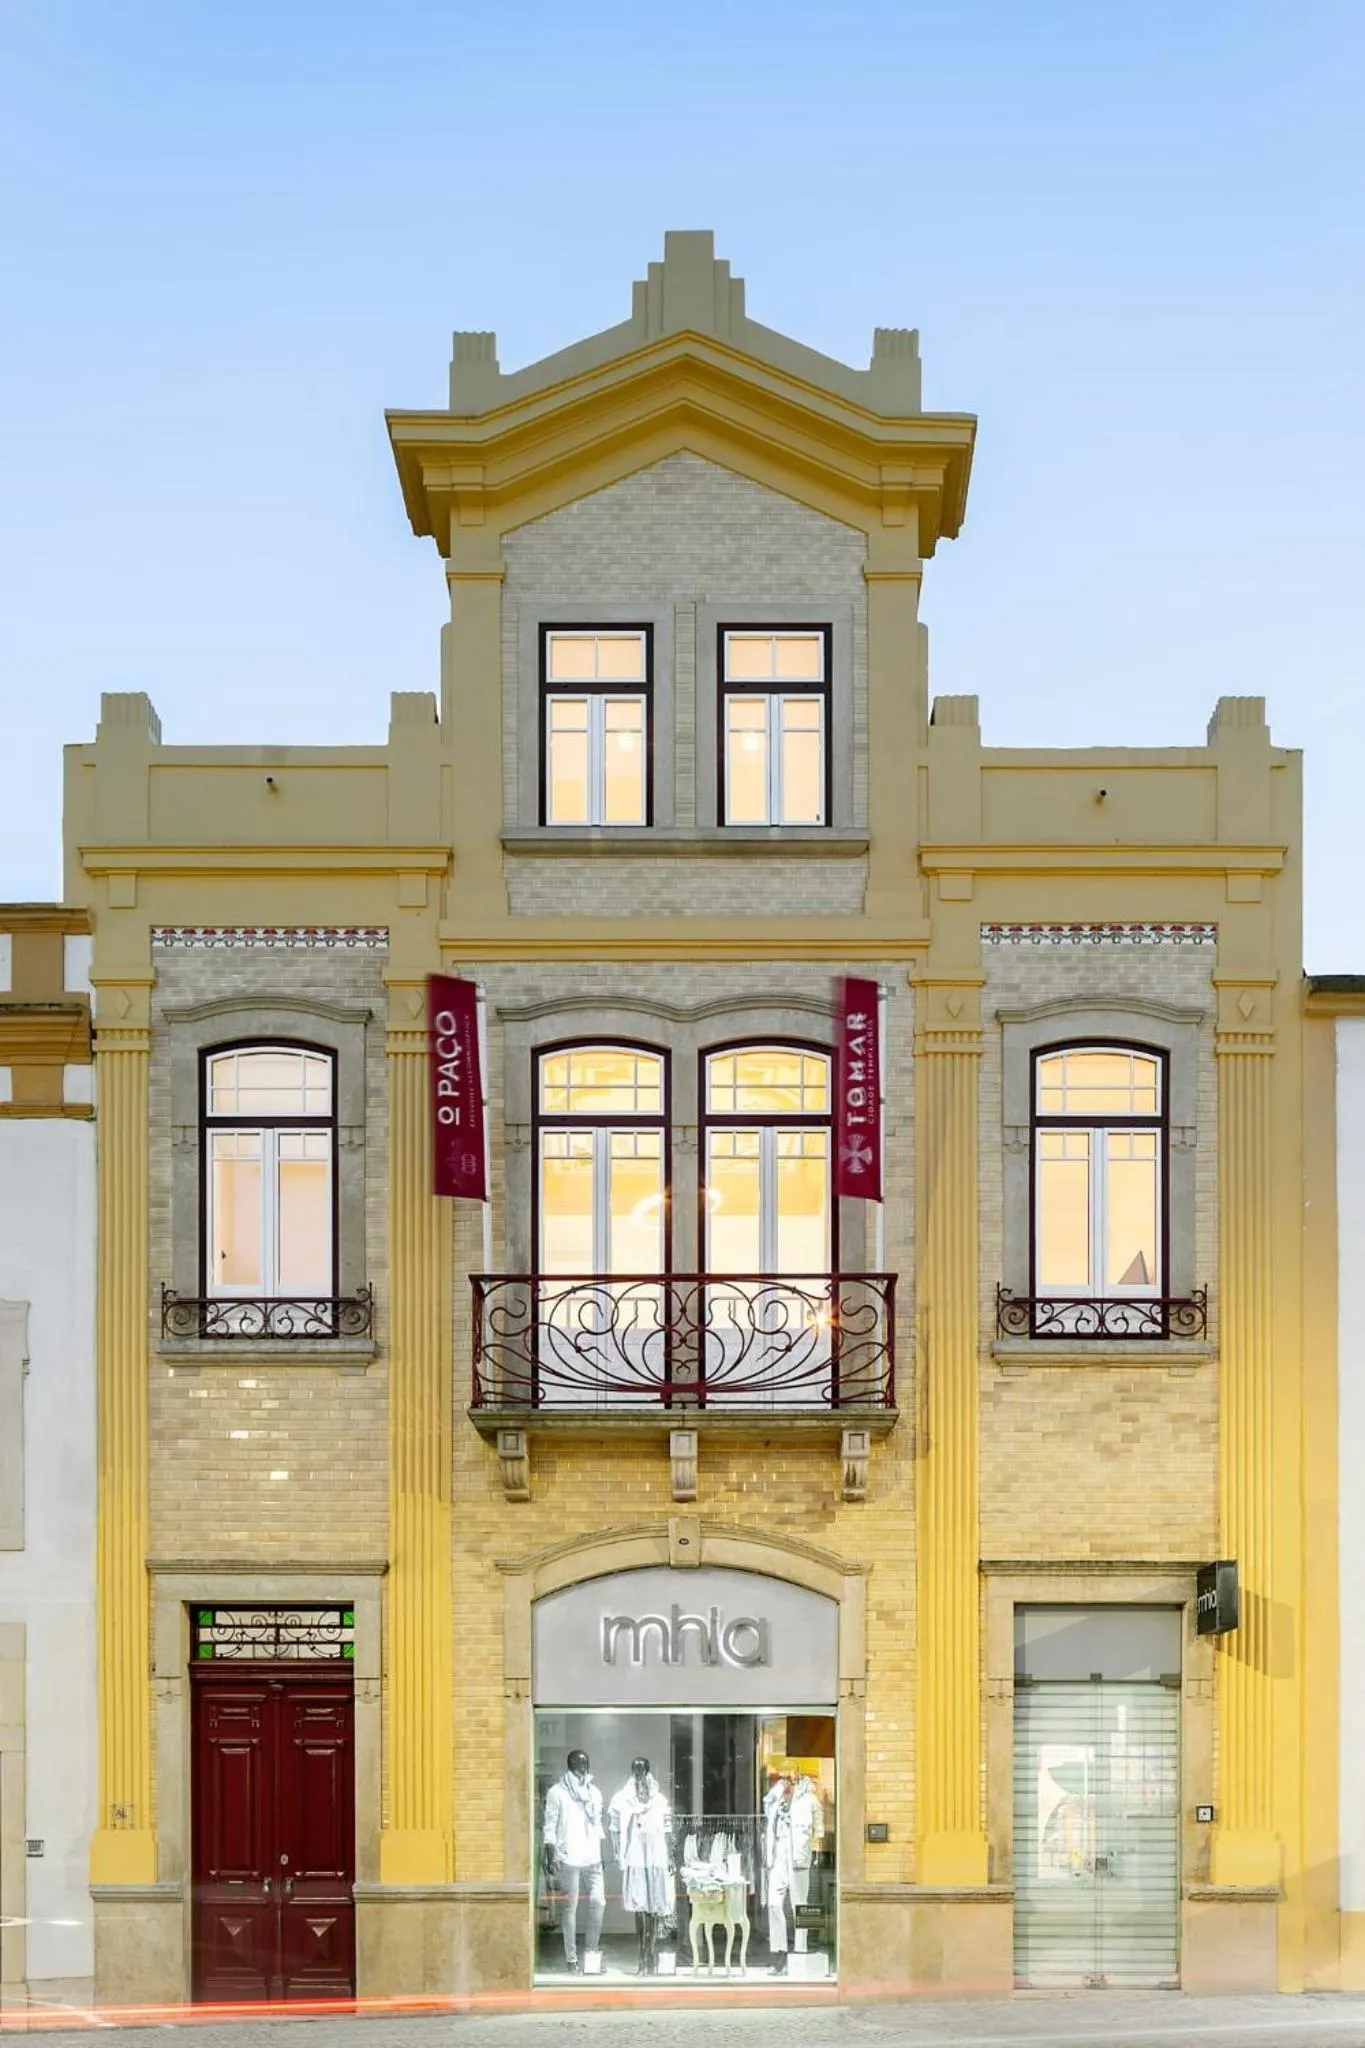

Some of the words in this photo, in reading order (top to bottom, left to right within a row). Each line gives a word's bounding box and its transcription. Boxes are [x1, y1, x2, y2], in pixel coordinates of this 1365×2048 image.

[435, 1010, 463, 1097] PAÇO
[847, 1013, 866, 1127] TOMAR
[437, 1106, 460, 1126] O
[867, 1085, 875, 1125] CIDADE
